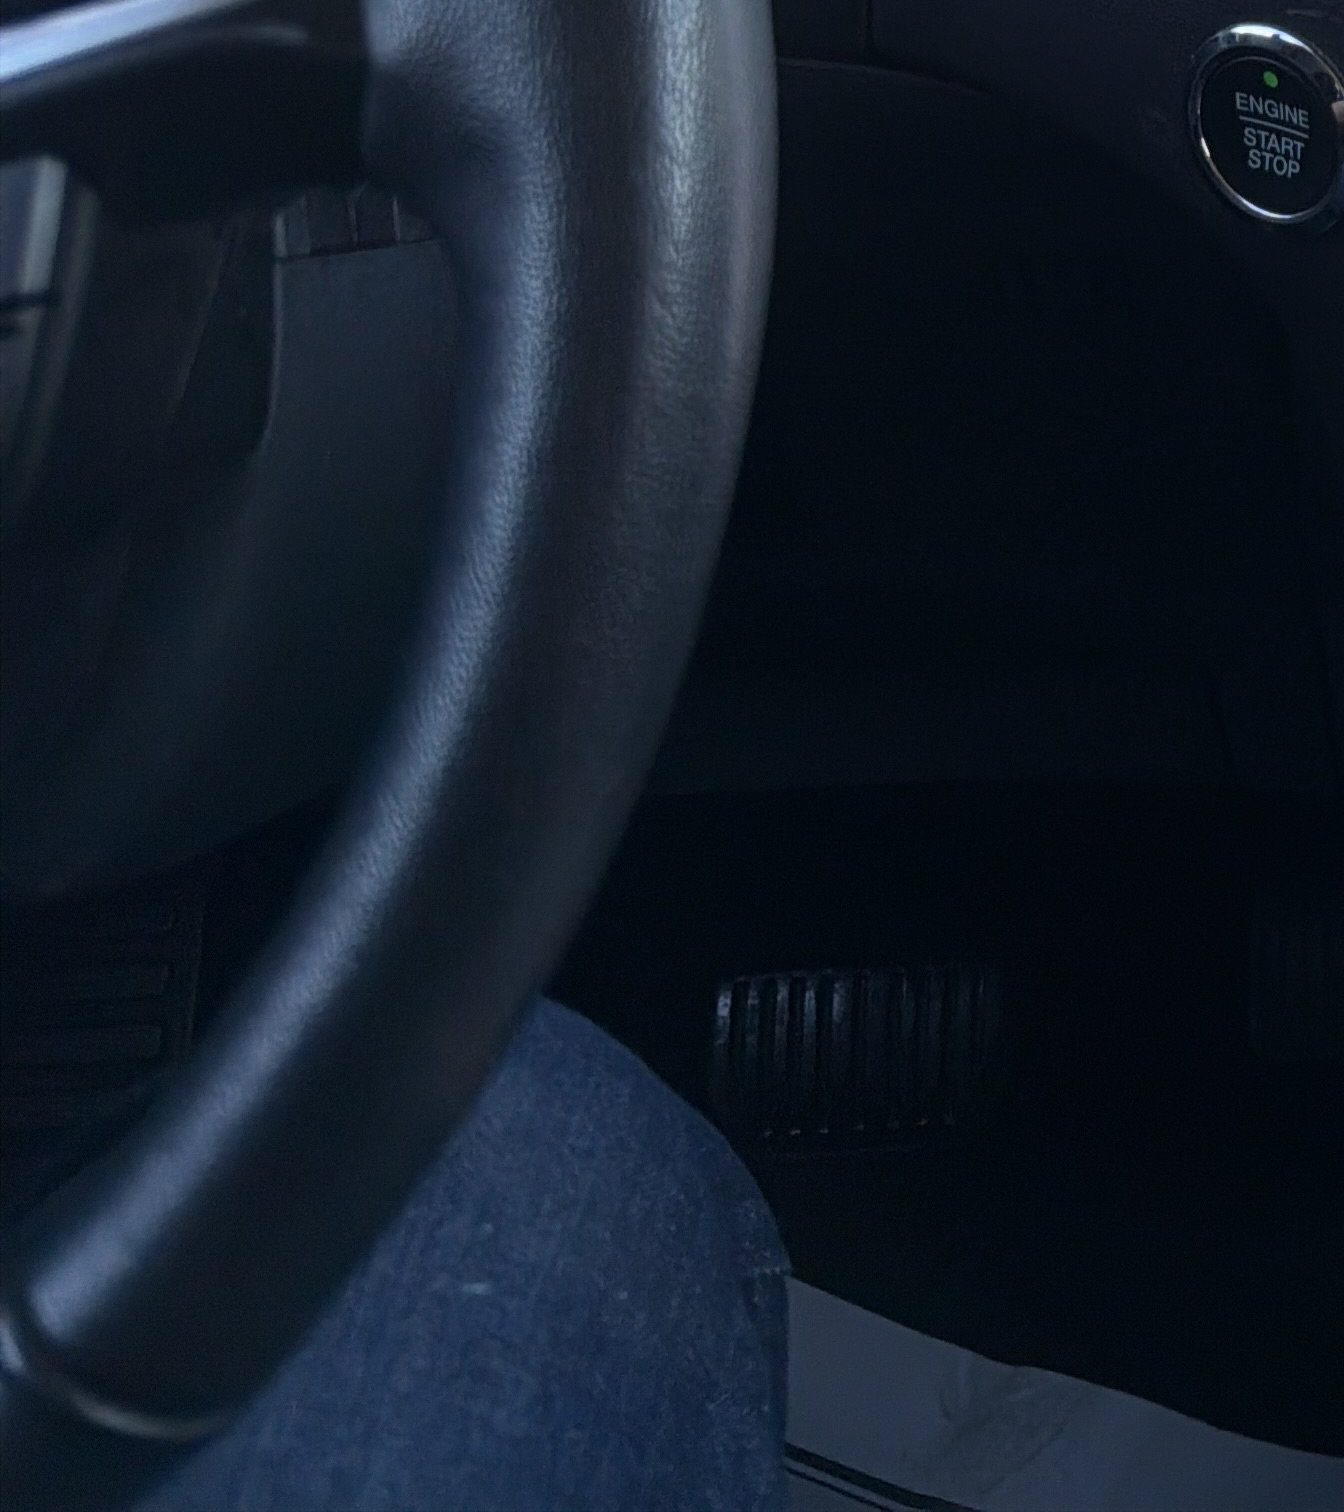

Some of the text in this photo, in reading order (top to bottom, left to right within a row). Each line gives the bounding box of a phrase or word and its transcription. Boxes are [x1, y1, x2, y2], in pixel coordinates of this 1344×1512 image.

[1235, 92, 1309, 129] ENGINE
[1243, 127, 1304, 160] START
[1248, 150, 1300, 178] STOP
